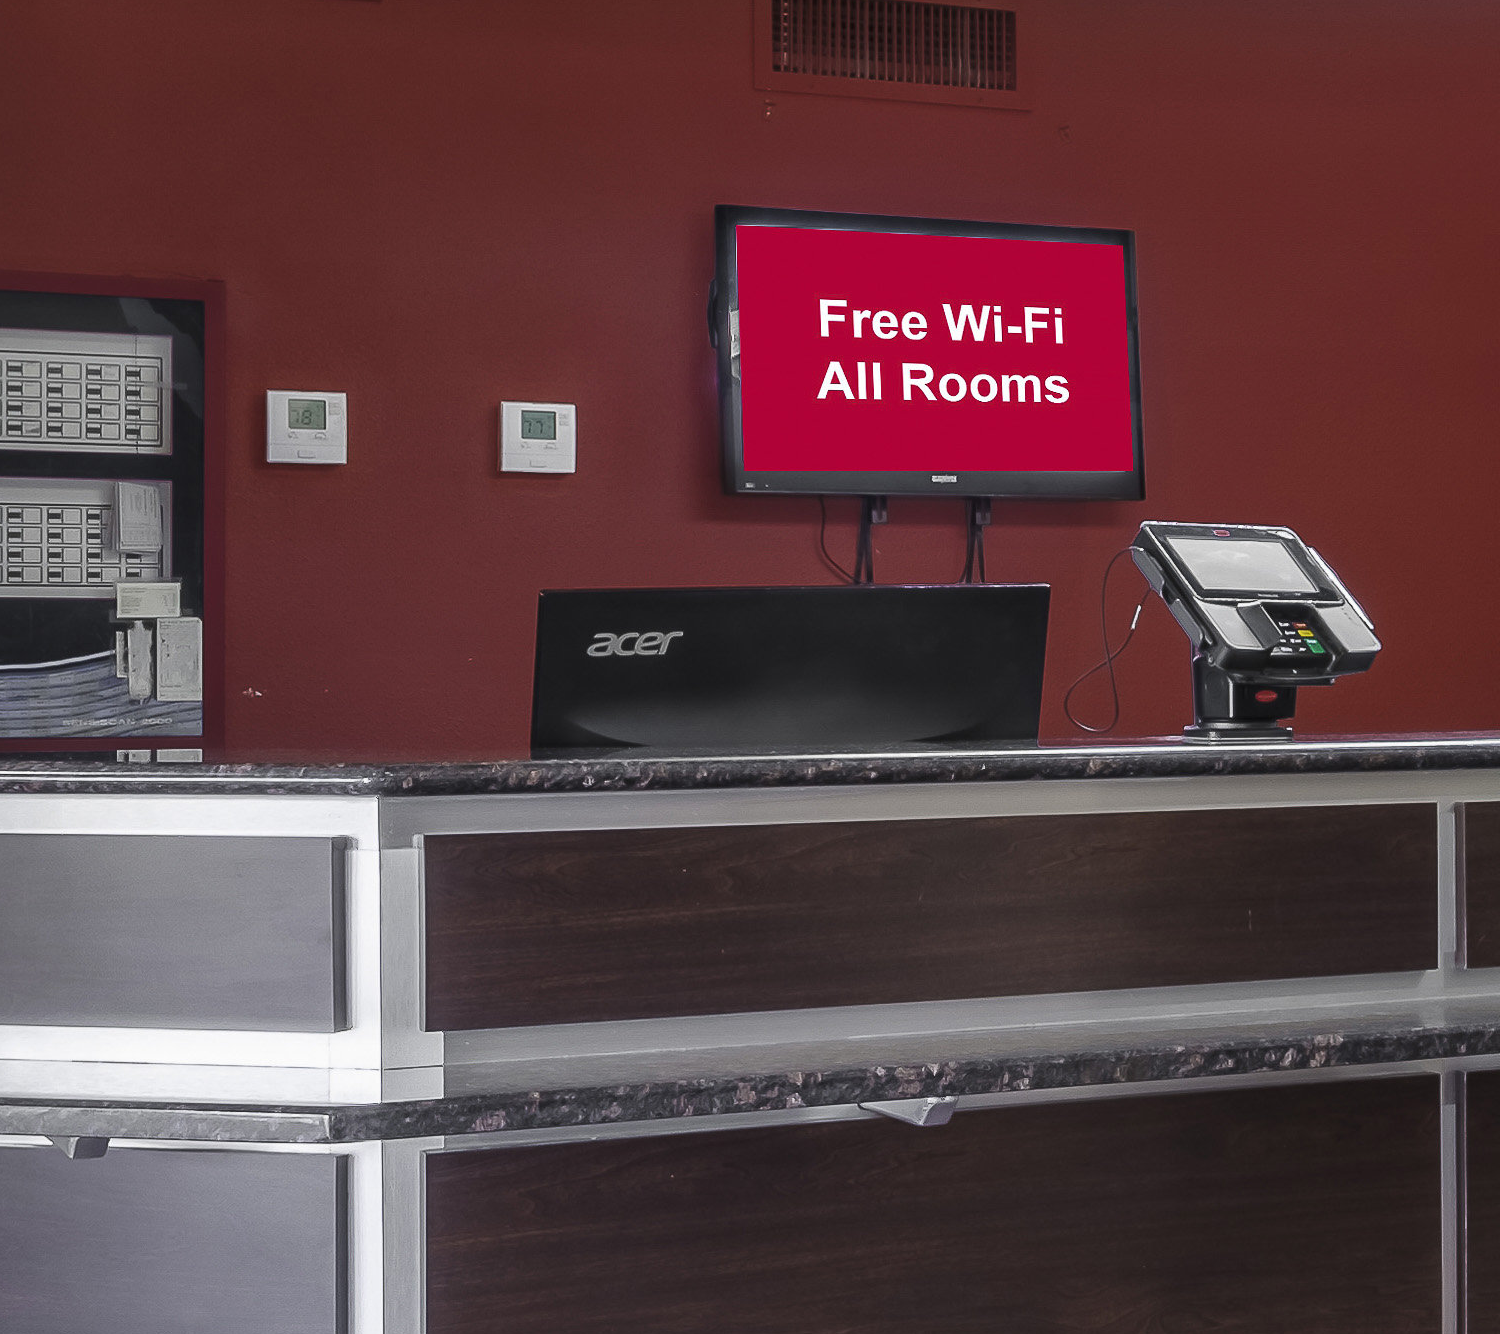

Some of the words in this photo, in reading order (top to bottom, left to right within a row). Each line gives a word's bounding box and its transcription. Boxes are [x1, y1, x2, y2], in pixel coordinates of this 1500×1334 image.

[819, 298, 928, 341] Free
[941, 303, 1064, 345] Wi-Fi
[816, 361, 882, 400] All
[901, 362, 1070, 404] Rooms
[586, 631, 684, 657] acer
